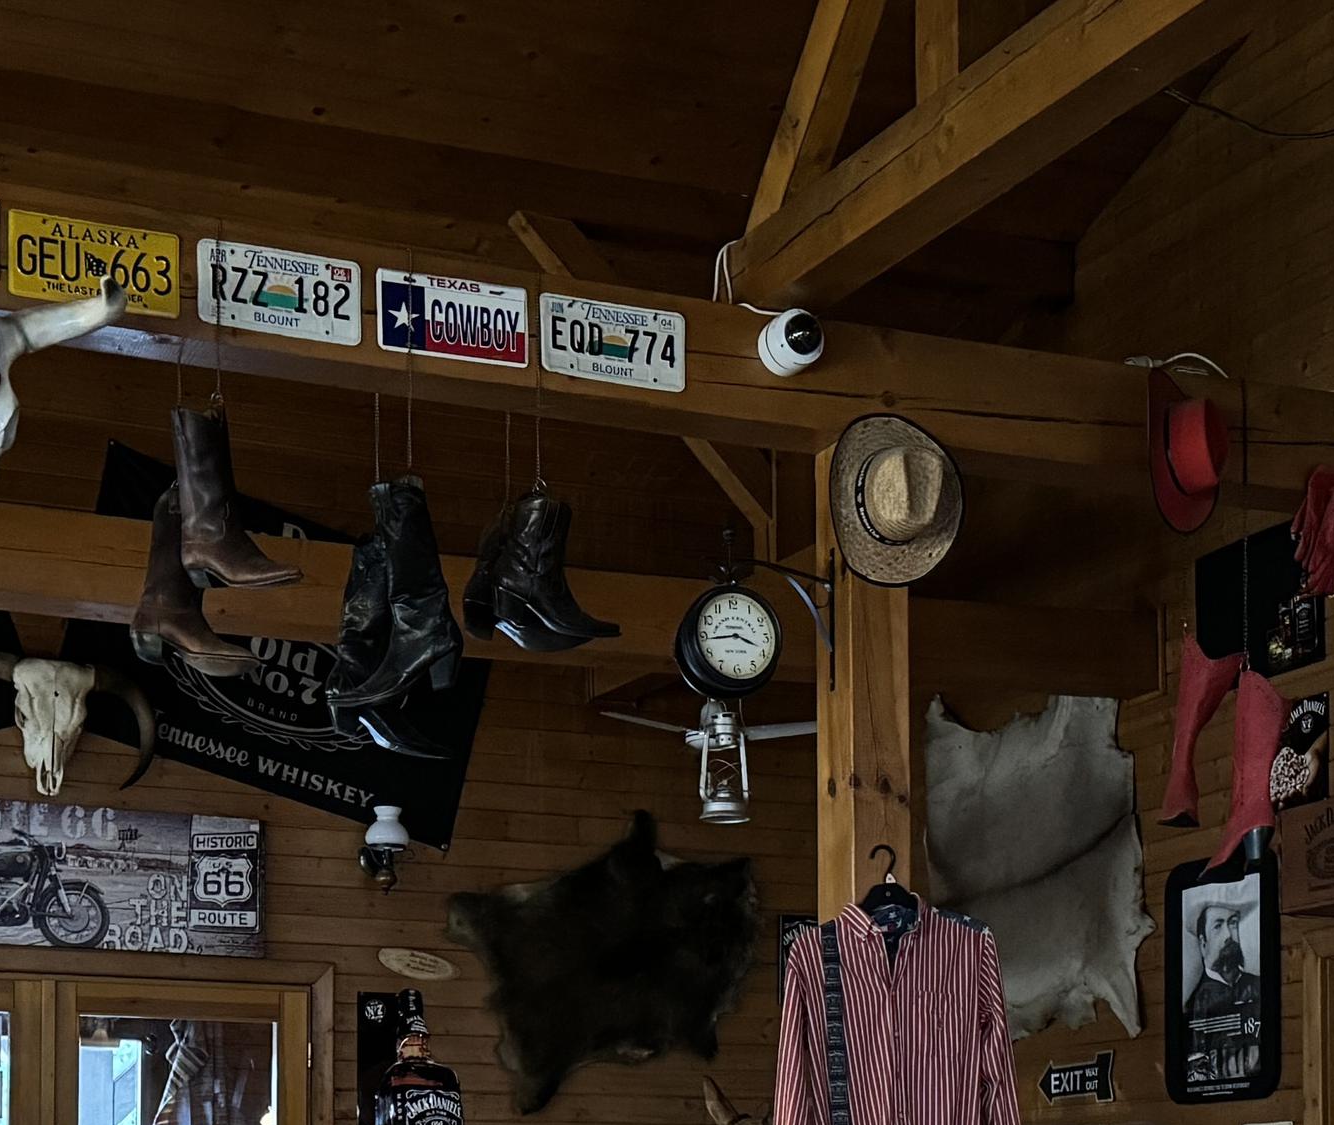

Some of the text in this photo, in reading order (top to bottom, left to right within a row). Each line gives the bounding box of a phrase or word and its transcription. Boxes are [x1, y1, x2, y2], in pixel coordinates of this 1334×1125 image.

[51, 222, 140, 250] ALASKA
[244, 249, 320, 277] TENNESSEE
[46, 281, 65, 293] THE
[67, 284, 96, 297] LAST
[426, 276, 481, 293] TEXAS
[253, 311, 301, 328] BLOUNT
[430, 299, 520, 353] COWBOY
[581, 302, 649, 327] TENNESSEE
[592, 362, 634, 377] BLOUNT
[250, 636, 320, 678] Old
[247, 697, 299, 722] BRAND
[256, 756, 375, 808] WHISKEY
[195, 835, 255, 849] HISTORIC
[147, 874, 188, 901] ON
[203, 869, 246, 897] 66
[128, 898, 189, 927] THE
[198, 912, 249, 926] ROUTE
[102, 924, 190, 954] ROAD
[1050, 1070, 1084, 1095] EXIT
[1085, 1080, 1099, 1091] OUT
[405, 1097, 429, 1119] JACK
